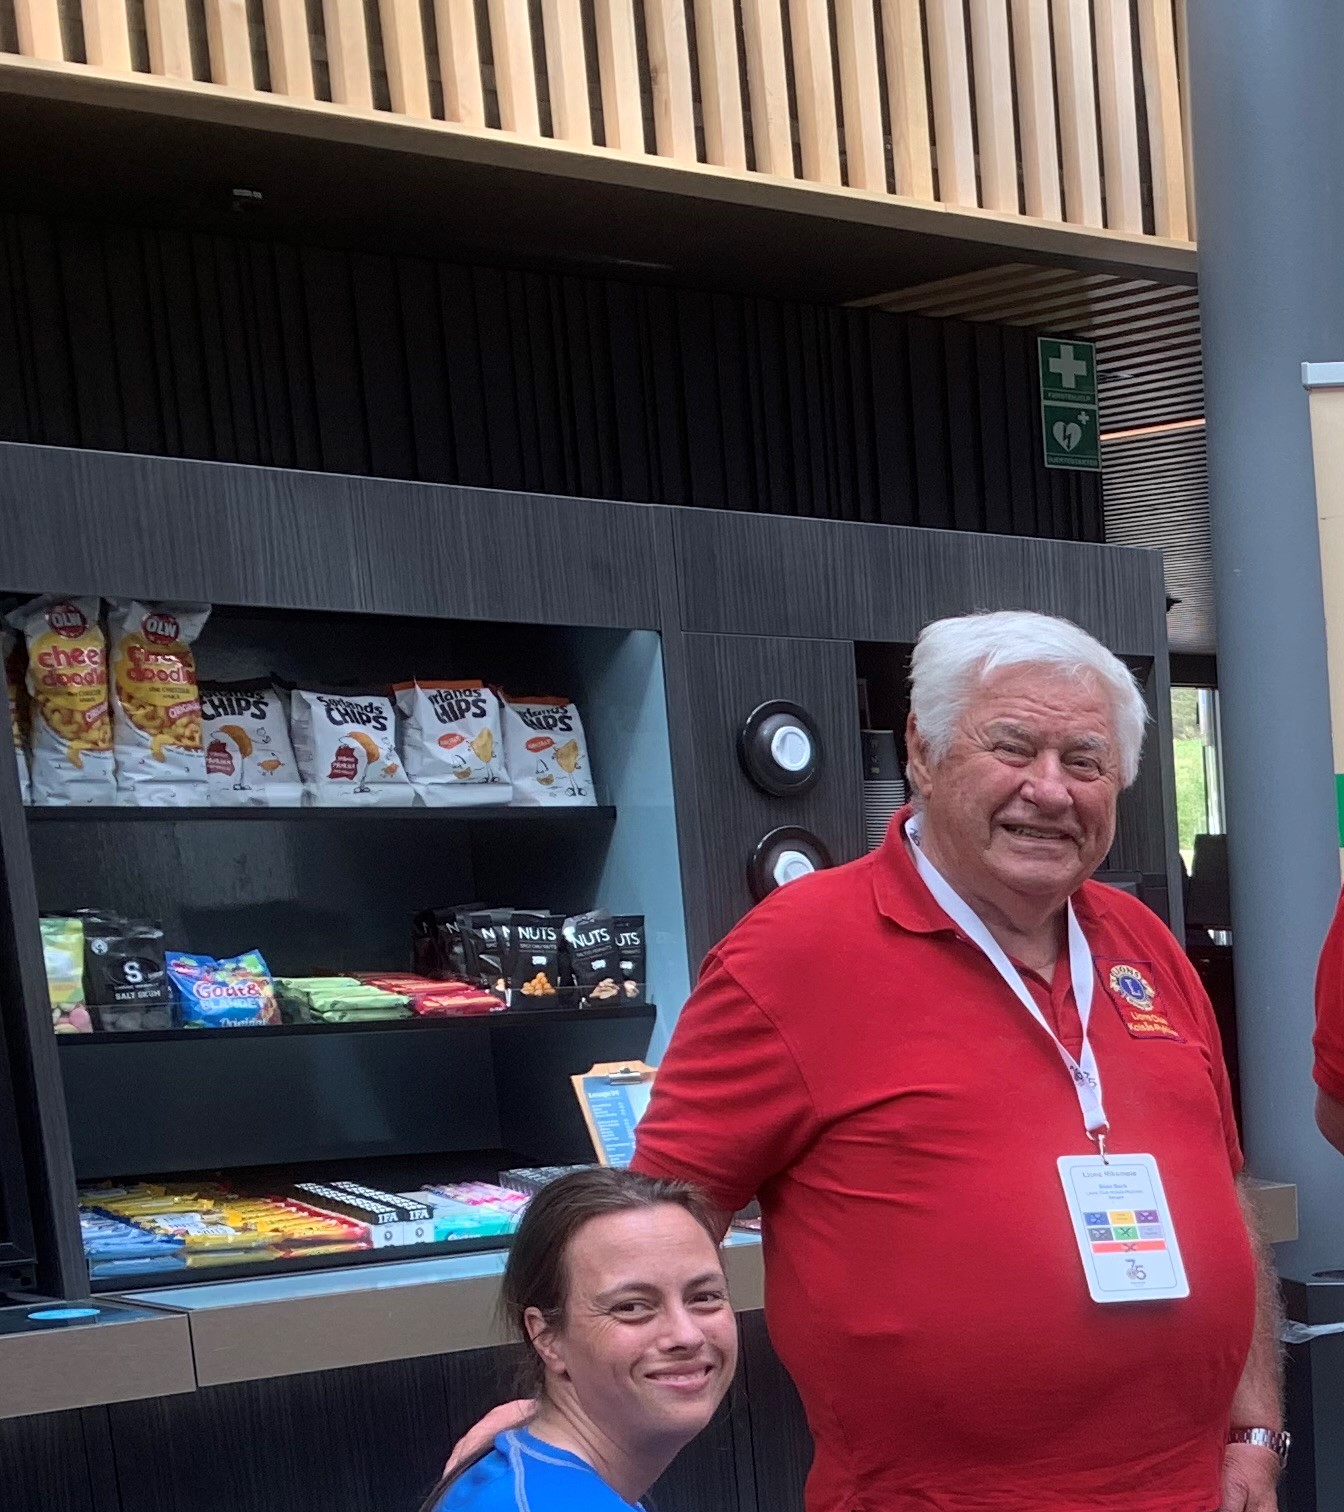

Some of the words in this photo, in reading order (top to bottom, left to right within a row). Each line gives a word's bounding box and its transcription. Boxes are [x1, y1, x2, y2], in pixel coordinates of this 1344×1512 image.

[53, 612, 82, 627] OLW
[147, 619, 177, 636] OLW
[326, 706, 388, 731] CHIPS
[518, 926, 557, 941] NUTS
[572, 927, 611, 949] NUTS
[115, 990, 135, 1000] SALT
[378, 1211, 399, 1224] IFA
[408, 1208, 429, 1222] IFA
